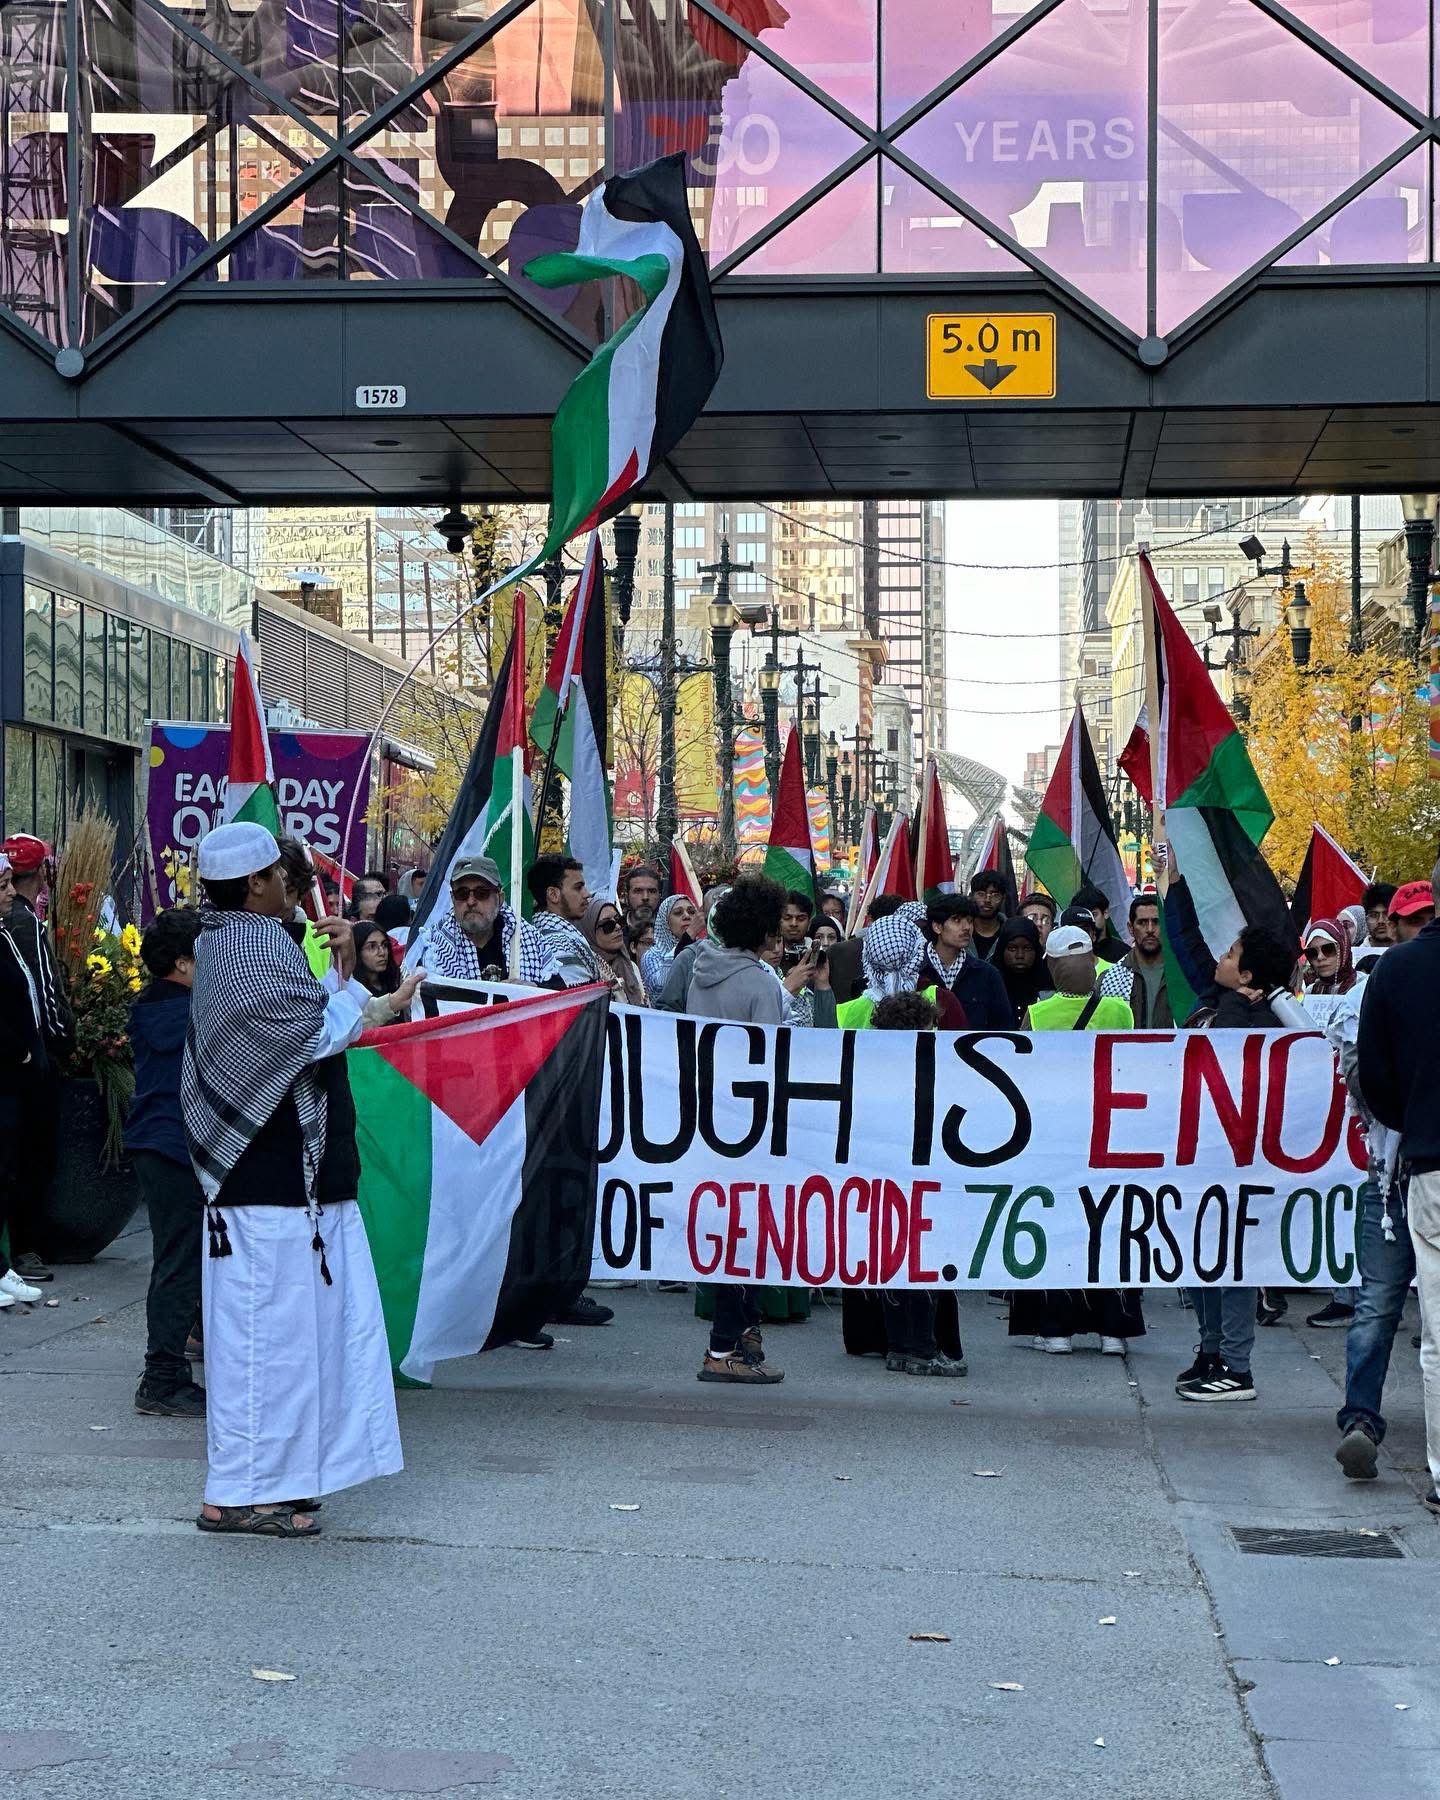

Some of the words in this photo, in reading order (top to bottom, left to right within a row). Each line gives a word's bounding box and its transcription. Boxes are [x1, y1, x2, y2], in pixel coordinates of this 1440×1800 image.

[691, 113, 780, 176] 50
[955, 117, 1135, 162] YEARS
[943, 322, 999, 353] 5.0
[1012, 329, 1040, 352] m
[363, 389, 398, 404] 1578
[700, 678, 709, 702] Walk
[703, 745, 714, 787] Stephen
[277, 777, 345, 809] DAY
[912, 1031, 1033, 1168] IS
[600, 1178, 673, 1271] OF
[964, 1184, 1055, 1281] 76
[1078, 1184, 1183, 1283] YRS
[1193, 1184, 1275, 1283] OF
[1281, 1183, 1366, 1284] OC
